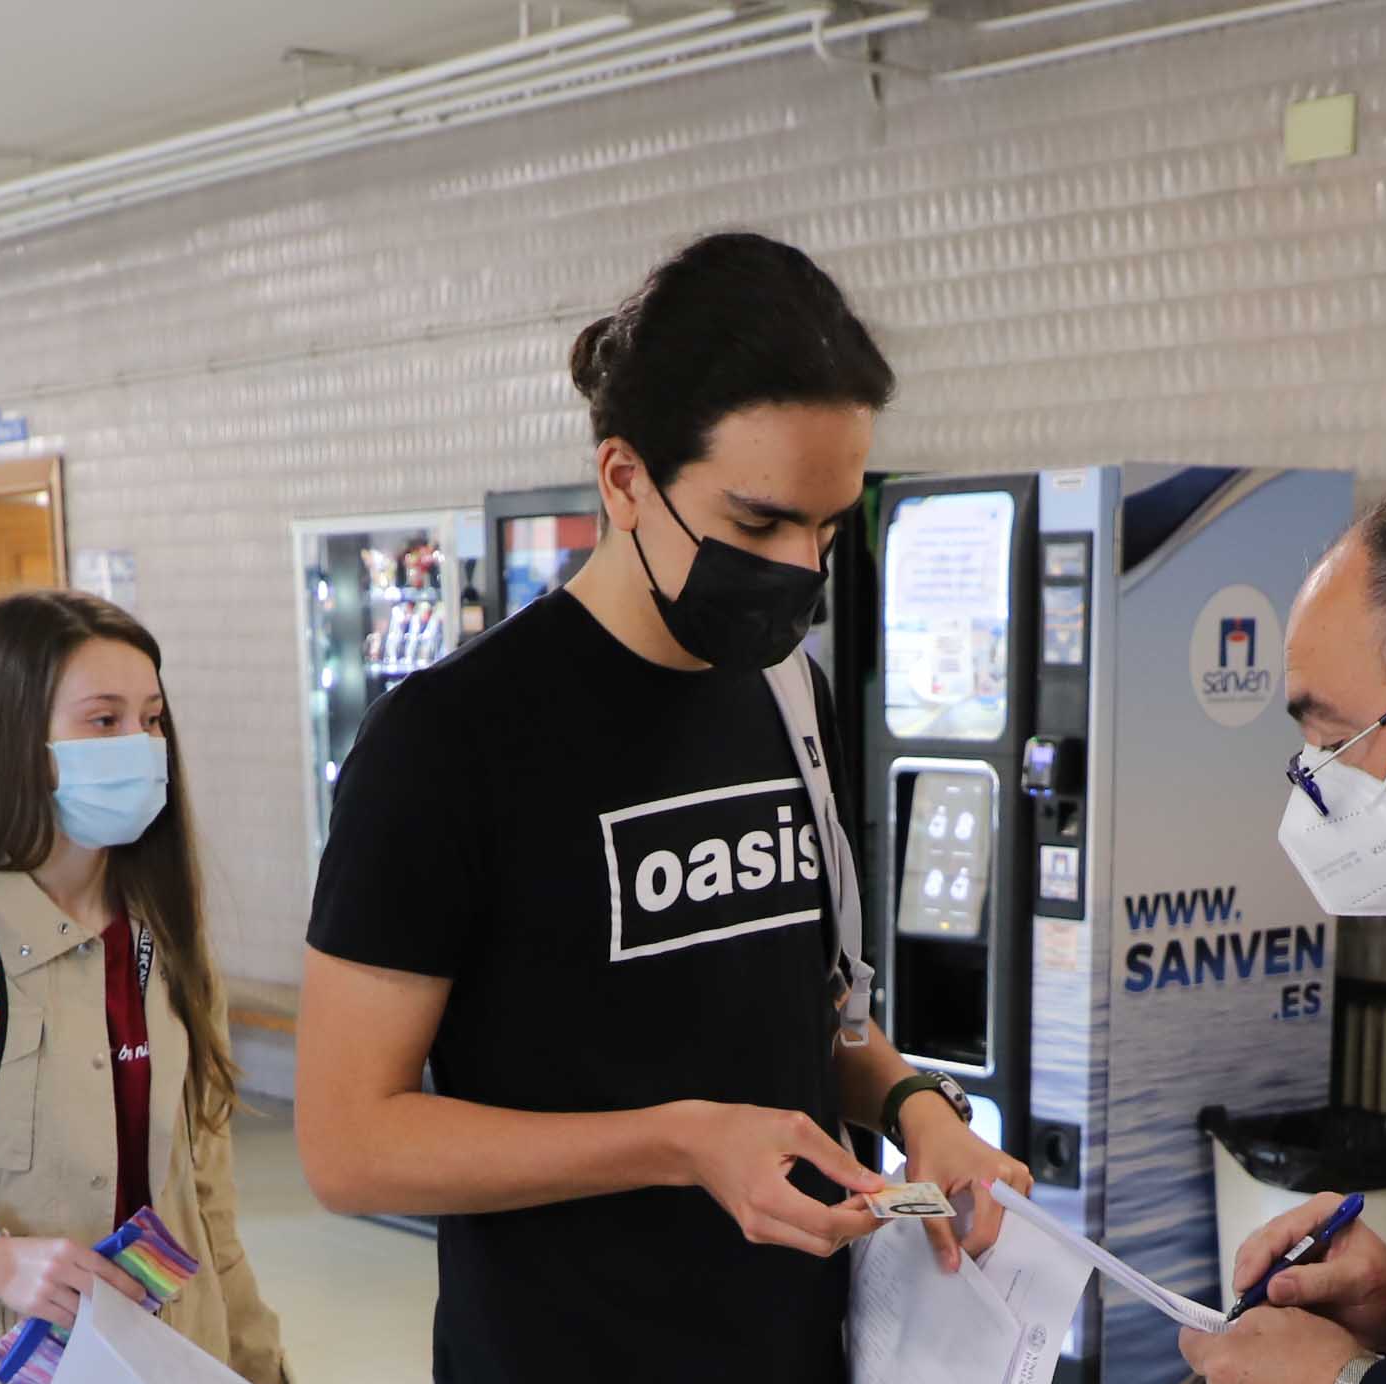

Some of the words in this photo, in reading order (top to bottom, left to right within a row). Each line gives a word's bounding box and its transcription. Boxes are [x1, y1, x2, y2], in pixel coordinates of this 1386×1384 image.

[1202, 669, 1270, 694] sanven
[635, 805, 819, 912] oasis
[1124, 886, 1241, 930] WWW.
[1124, 923, 1325, 992] SANVEN
[1271, 982, 1321, 1020] .ES
